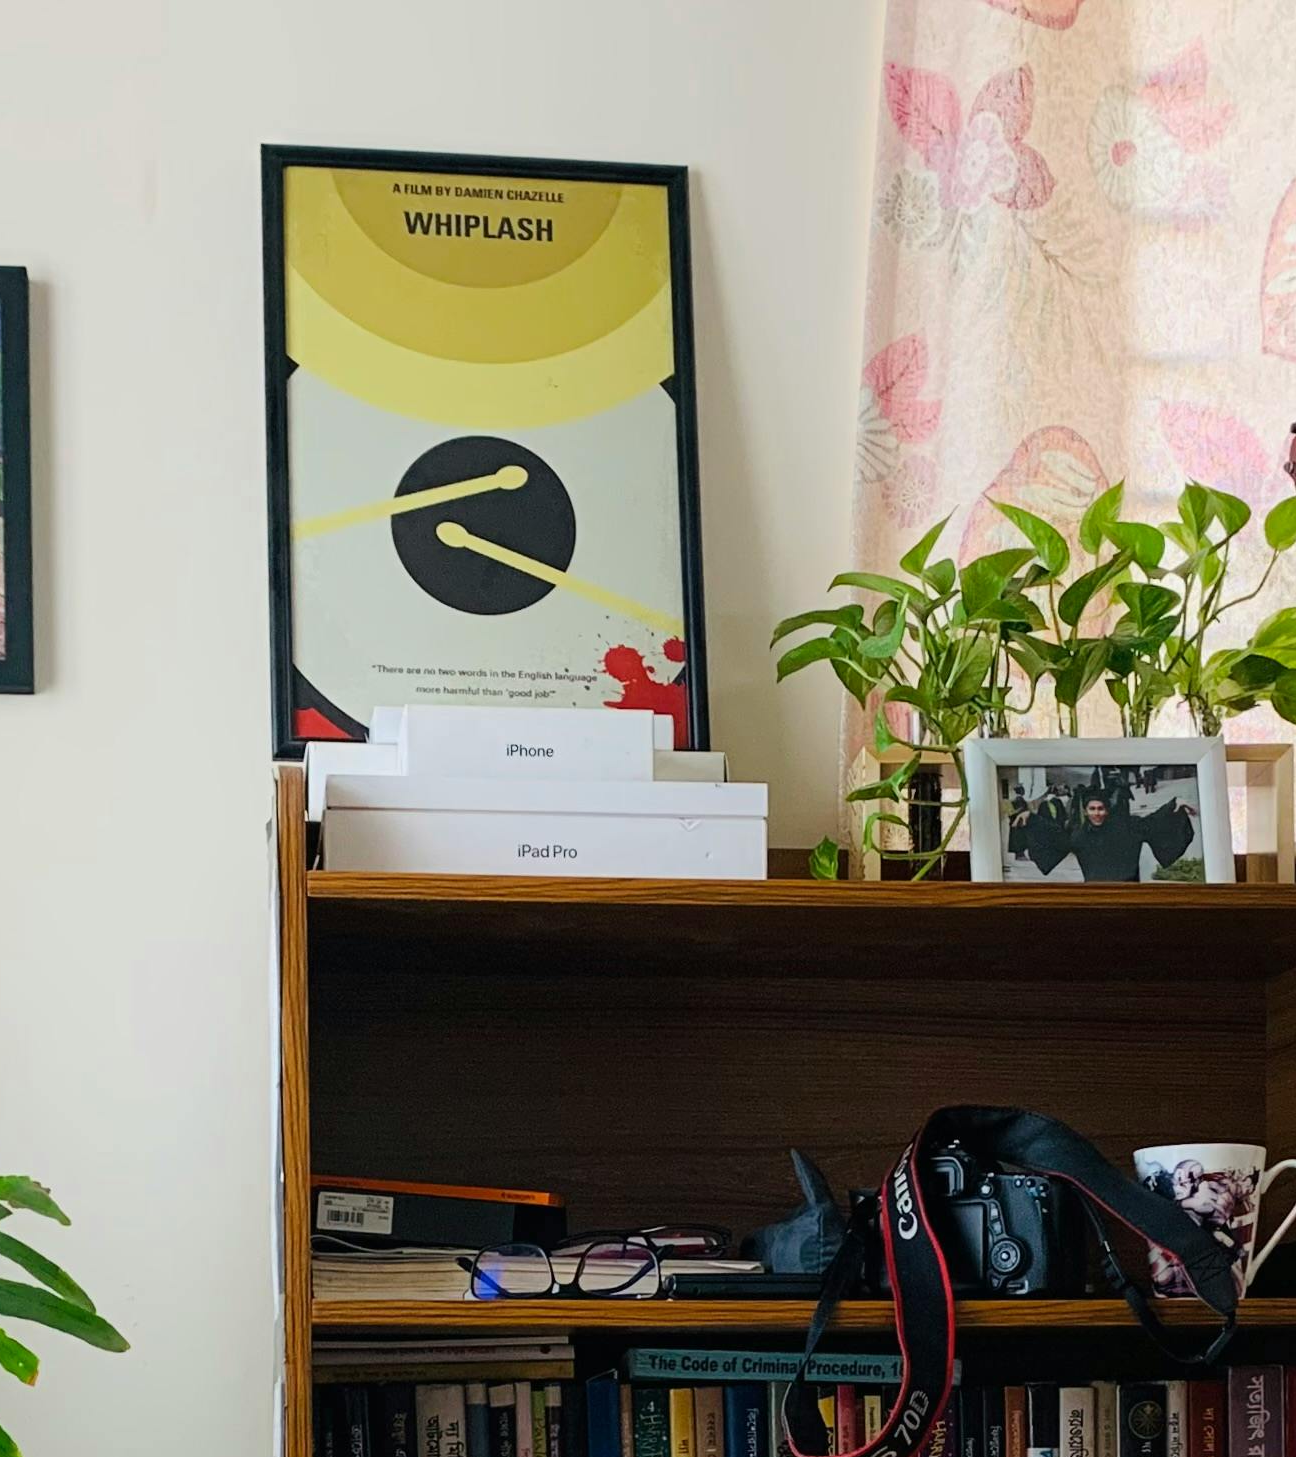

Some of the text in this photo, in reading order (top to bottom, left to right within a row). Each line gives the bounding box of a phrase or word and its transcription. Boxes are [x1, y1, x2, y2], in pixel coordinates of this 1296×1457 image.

[393, 183, 565, 203] A FILM BY DAMIEN CHAZELLE
[404, 211, 554, 242] WHIPLASH
[406, 667, 598, 684] are no two words in the English language
[416, 686, 503, 697] more harmful than
[506, 744, 554, 759] iPhone
[517, 844, 578, 860] iPad Pro
[893, 1142, 918, 1240] Canon
[649, 1355, 886, 1379] The Code of Criminal Procedure,
[894, 1390, 930, 1446] 70D
[1246, 1375, 1270, 1441] সত্যজিৎ
[445, 1421, 460, 1437] দ্য
